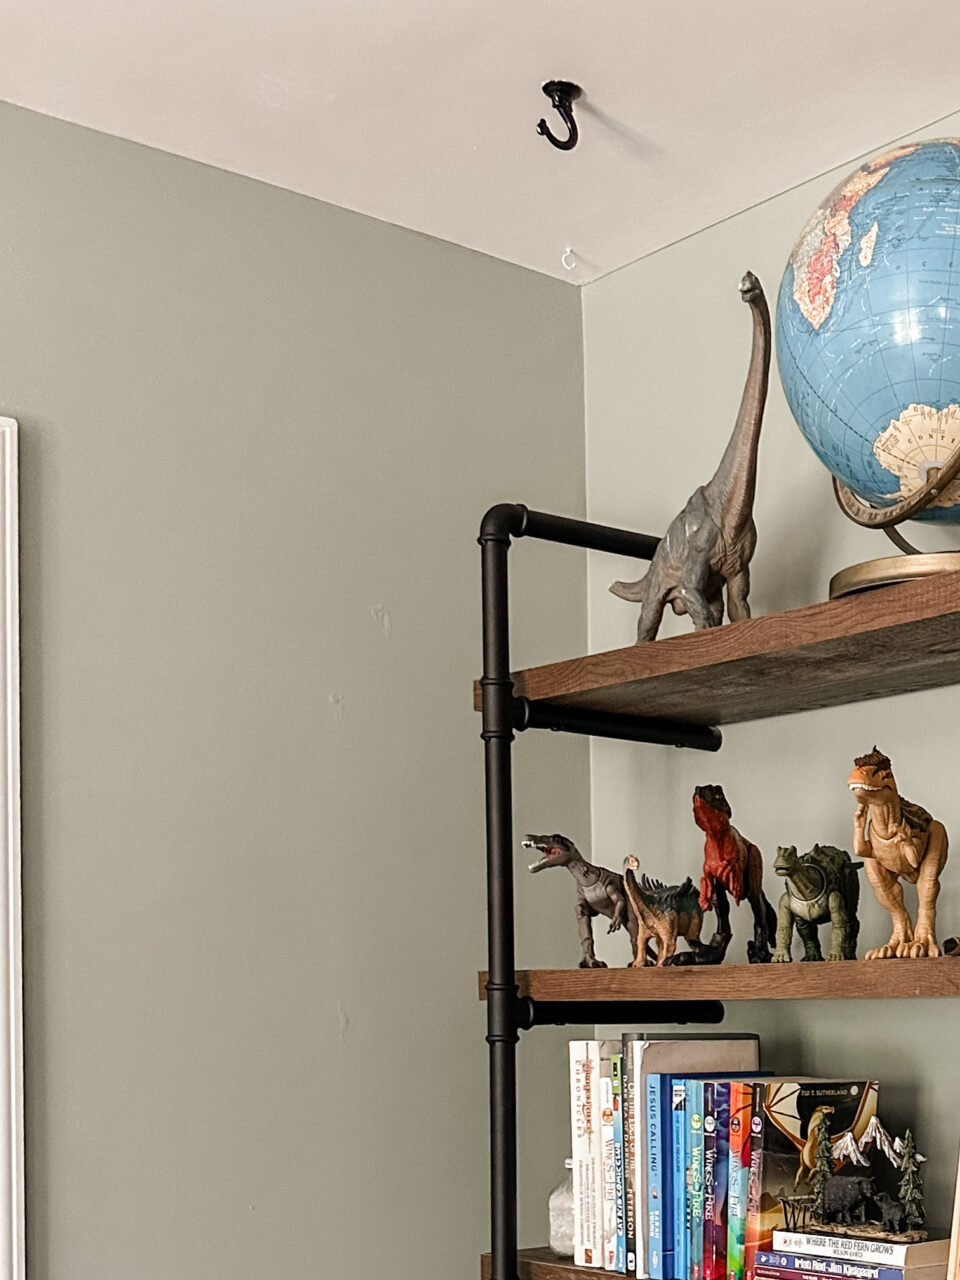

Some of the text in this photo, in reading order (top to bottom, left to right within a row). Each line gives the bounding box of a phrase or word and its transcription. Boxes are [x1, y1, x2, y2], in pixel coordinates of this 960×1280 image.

[628, 1083, 635, 1098] ON
[649, 1084, 657, 1120] JESUS
[605, 1138, 614, 1173] WINGS
[629, 1144, 635, 1155] OF
[692, 1146, 702, 1182] WINGS
[705, 1148, 717, 1185] WINGS
[731, 1150, 740, 1186] WINGS
[749, 1150, 761, 1185] WINGS
[692, 1190, 702, 1217] FIRE
[705, 1194, 715, 1220] FIRE
[806, 1236, 894, 1255] WHERE THE RED FERN GROWS
[794, 1257, 812, 1270] Irish
[843, 1263, 879, 1279] Kjelgaard
